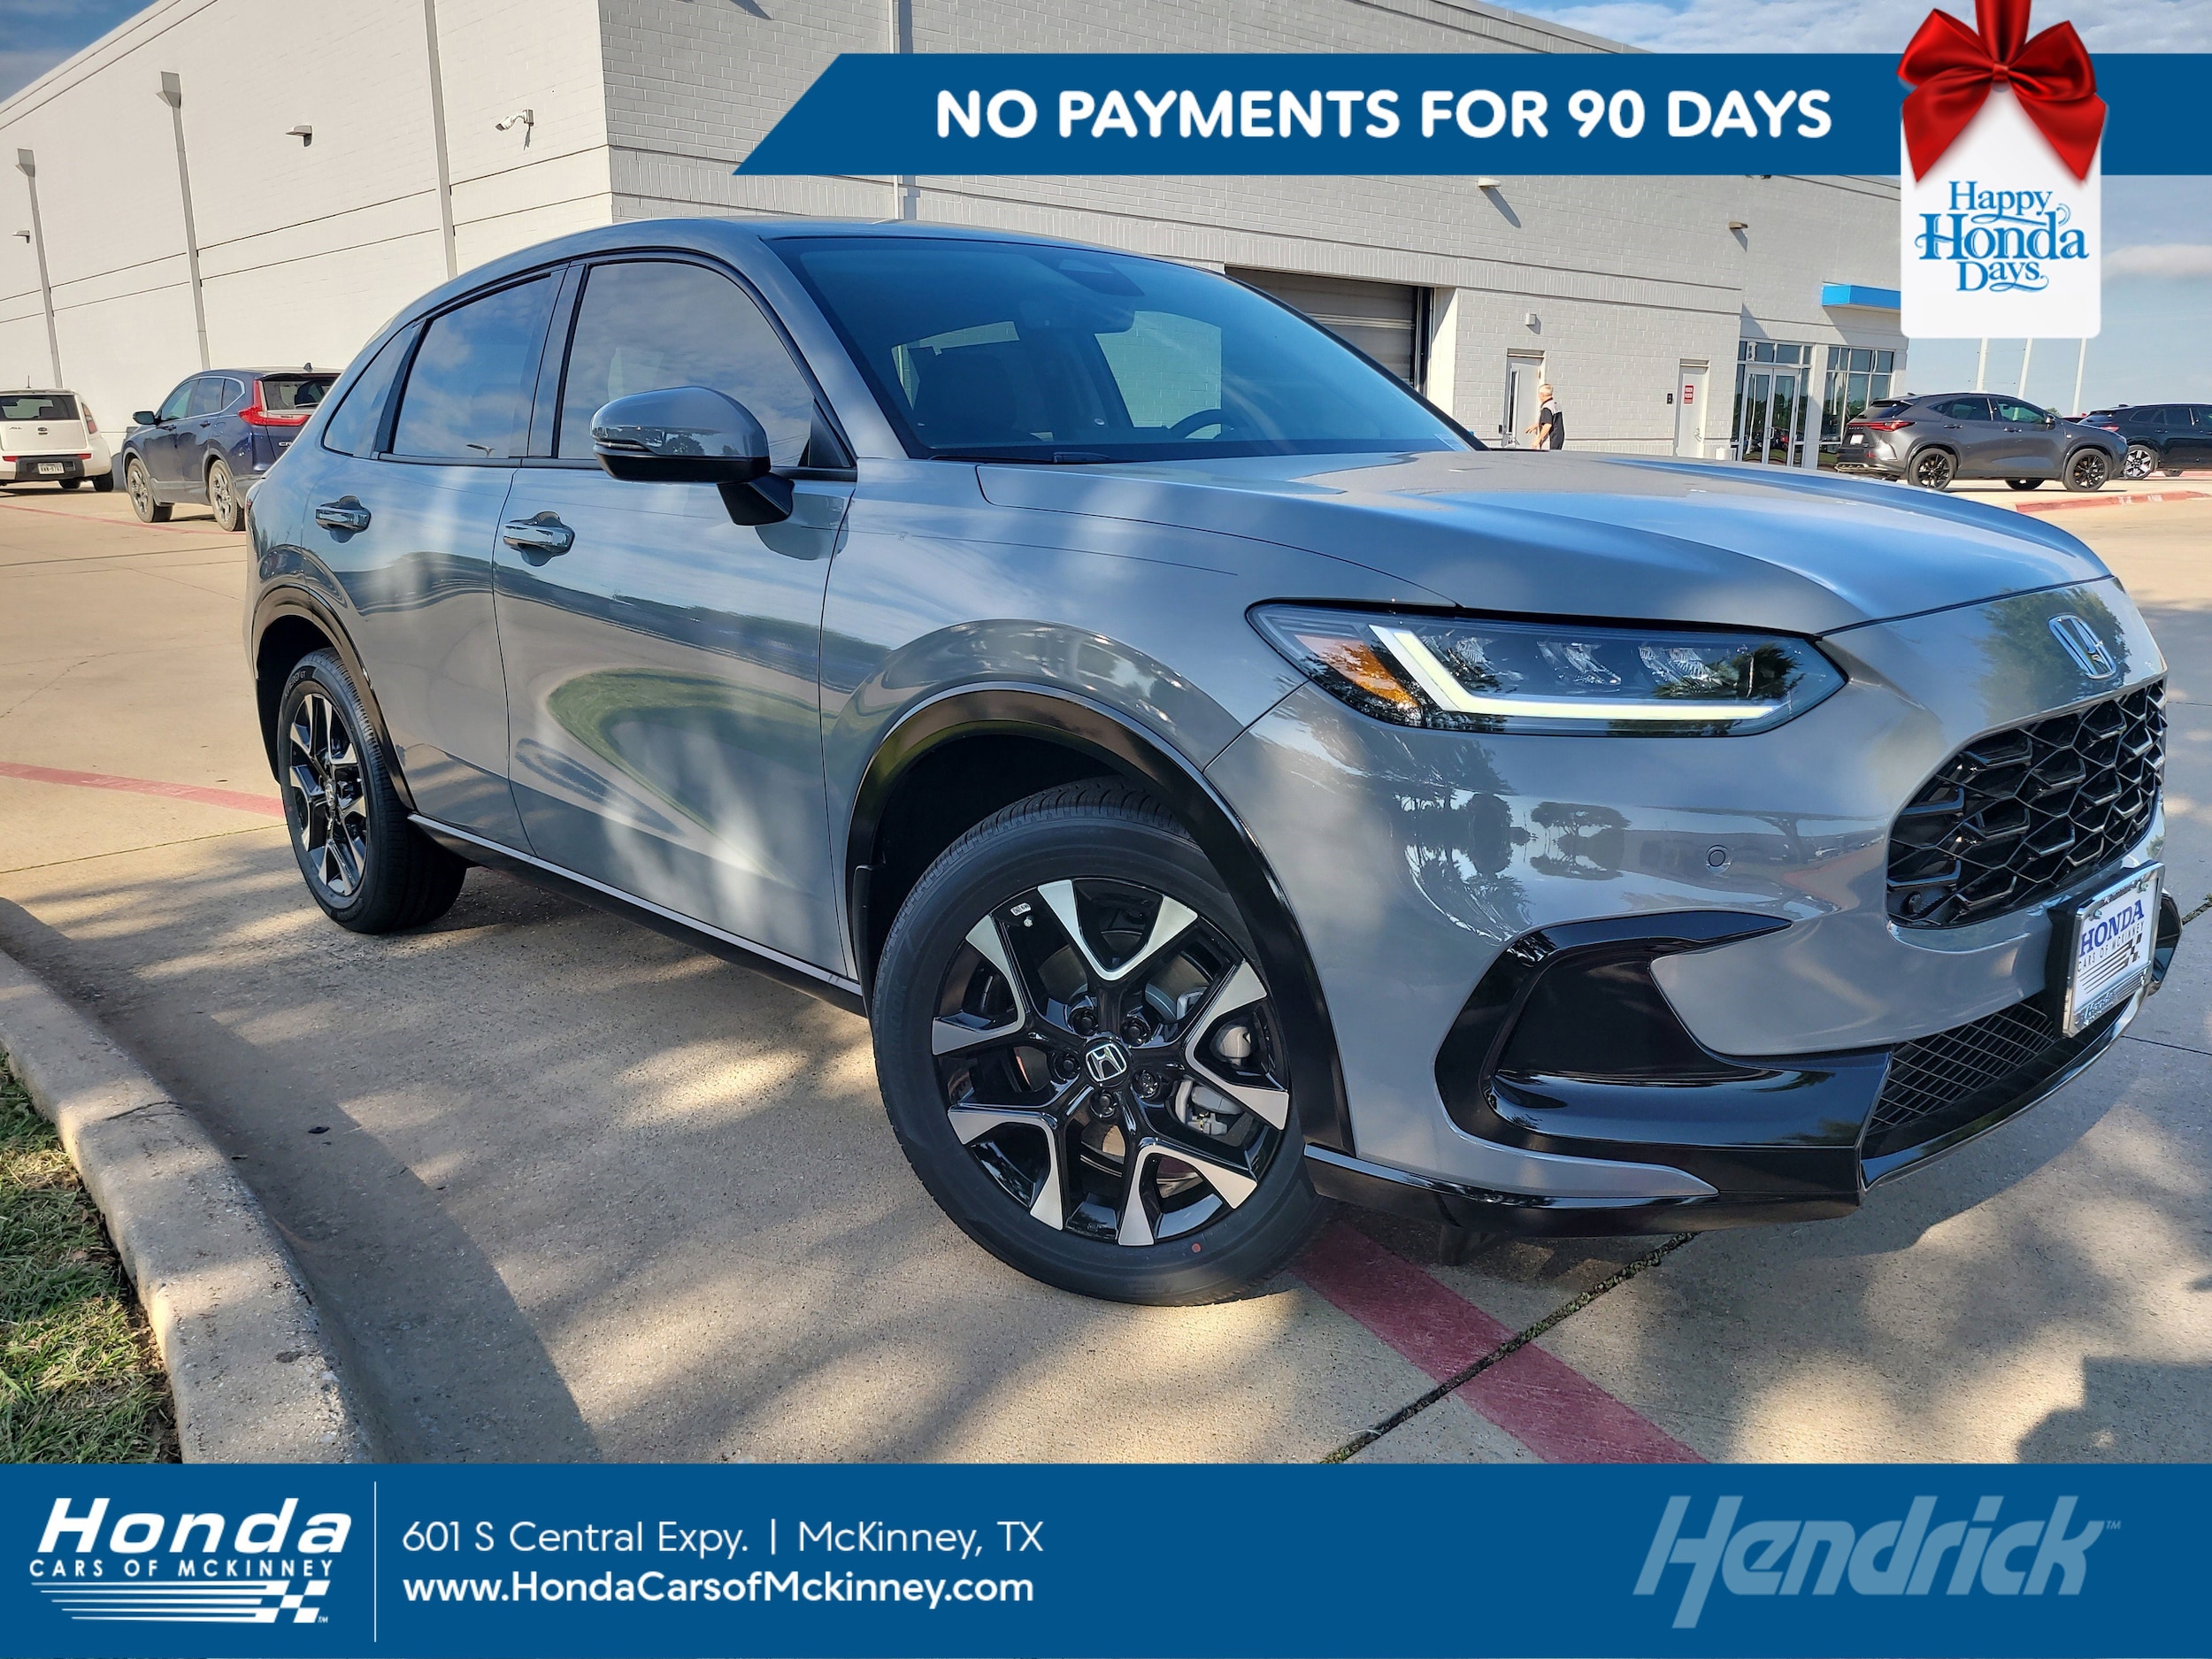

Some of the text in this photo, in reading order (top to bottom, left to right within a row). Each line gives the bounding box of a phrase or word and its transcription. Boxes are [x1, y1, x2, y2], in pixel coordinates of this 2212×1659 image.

[2079, 899, 2145, 957] HONDA
[2078, 952, 2096, 972] CARS
[2100, 944, 2108, 958] OF
